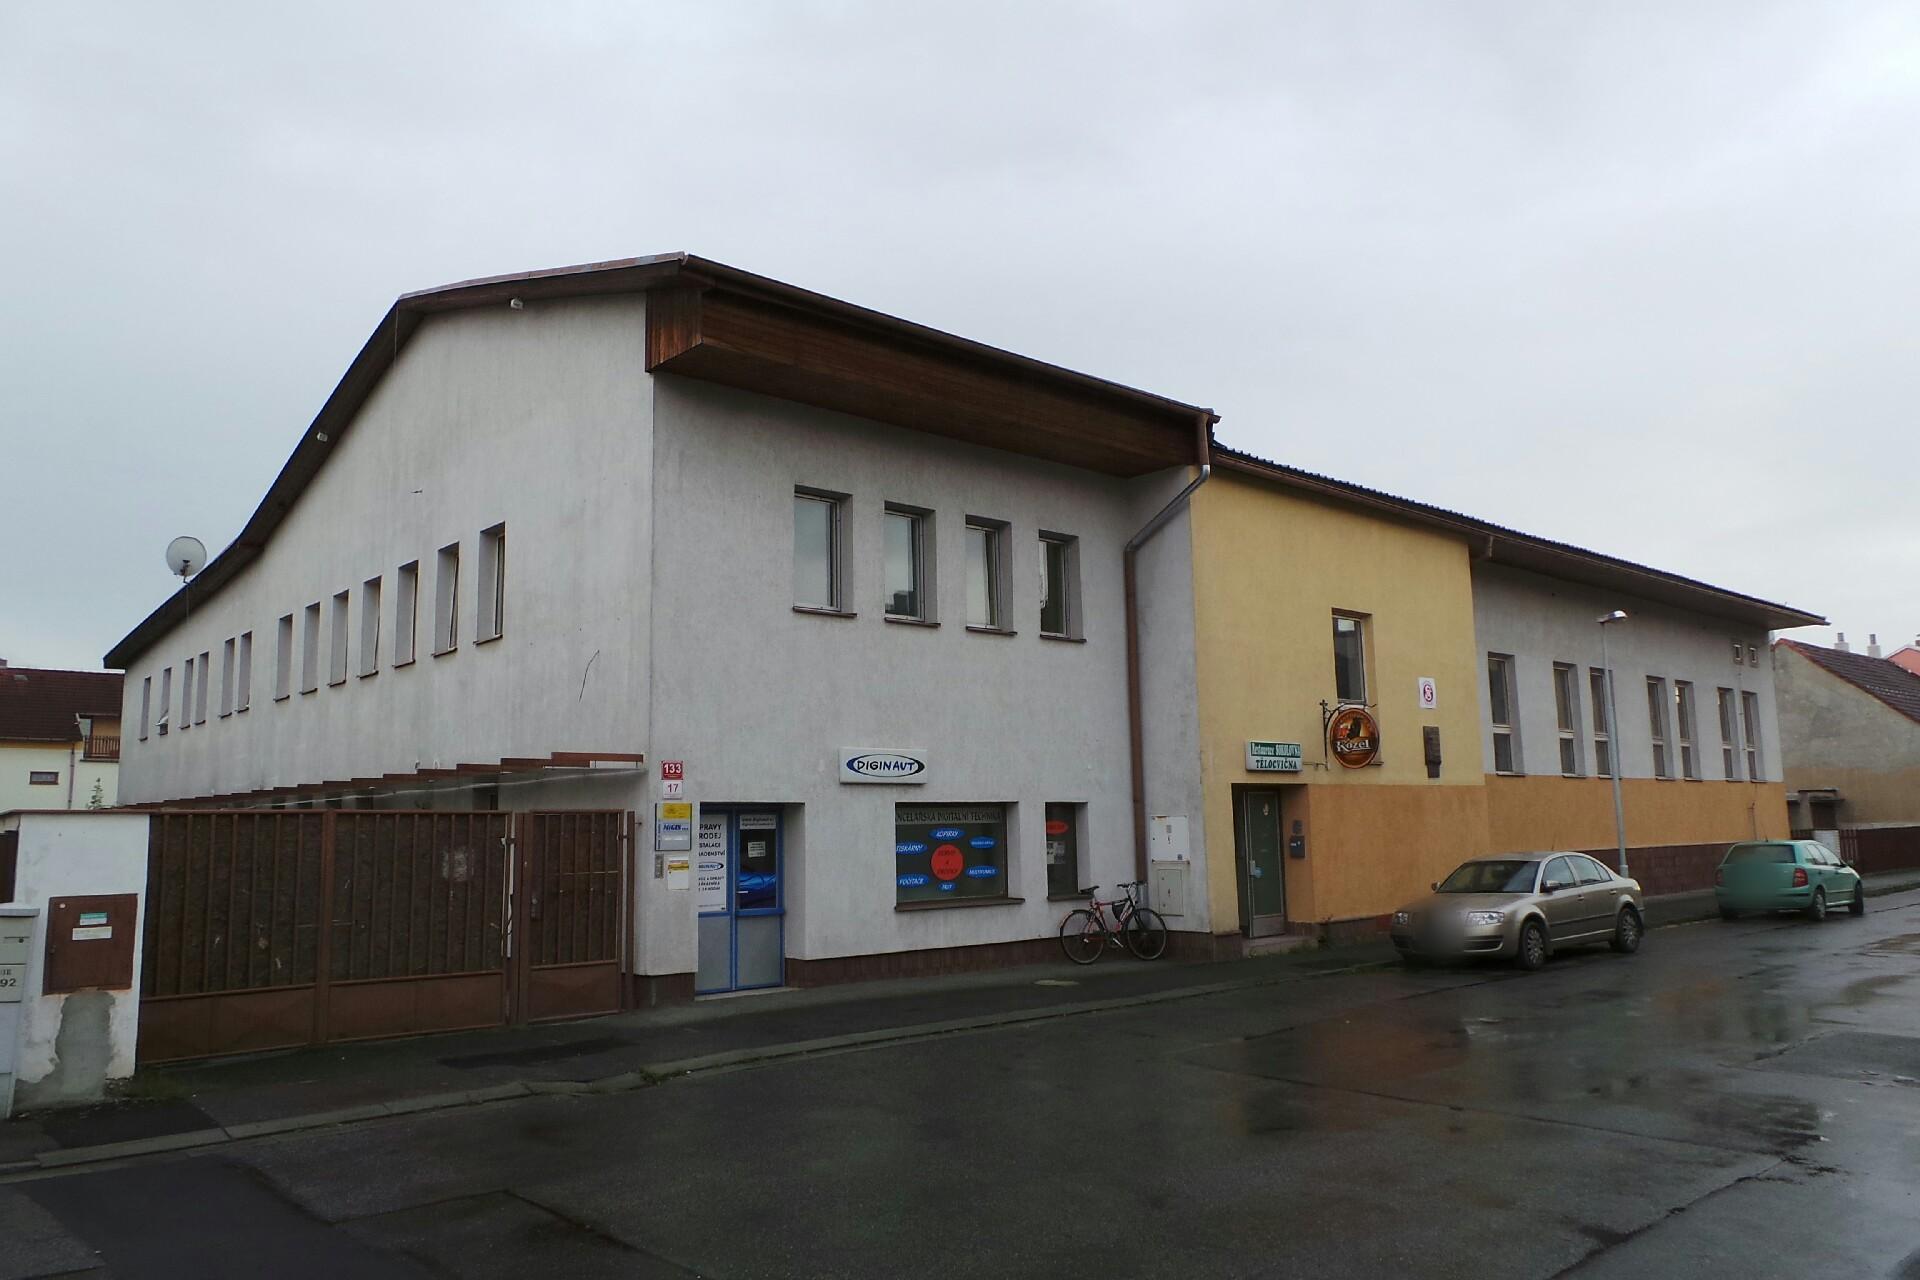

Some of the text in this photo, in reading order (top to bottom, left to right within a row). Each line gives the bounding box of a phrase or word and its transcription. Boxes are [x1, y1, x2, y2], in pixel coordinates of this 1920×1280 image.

[1335, 739, 1372, 752] Kozel
[857, 760, 915, 772] DIGINAUT
[1255, 757, 1298, 769] TĚLOCVIČNA
[664, 763, 682, 774] 133
[667, 783, 679, 793] 17
[699, 823, 722, 832] PRAVY
[699, 832, 722, 840] RODEJ
[698, 849, 726, 857] ADENSTVÍ
